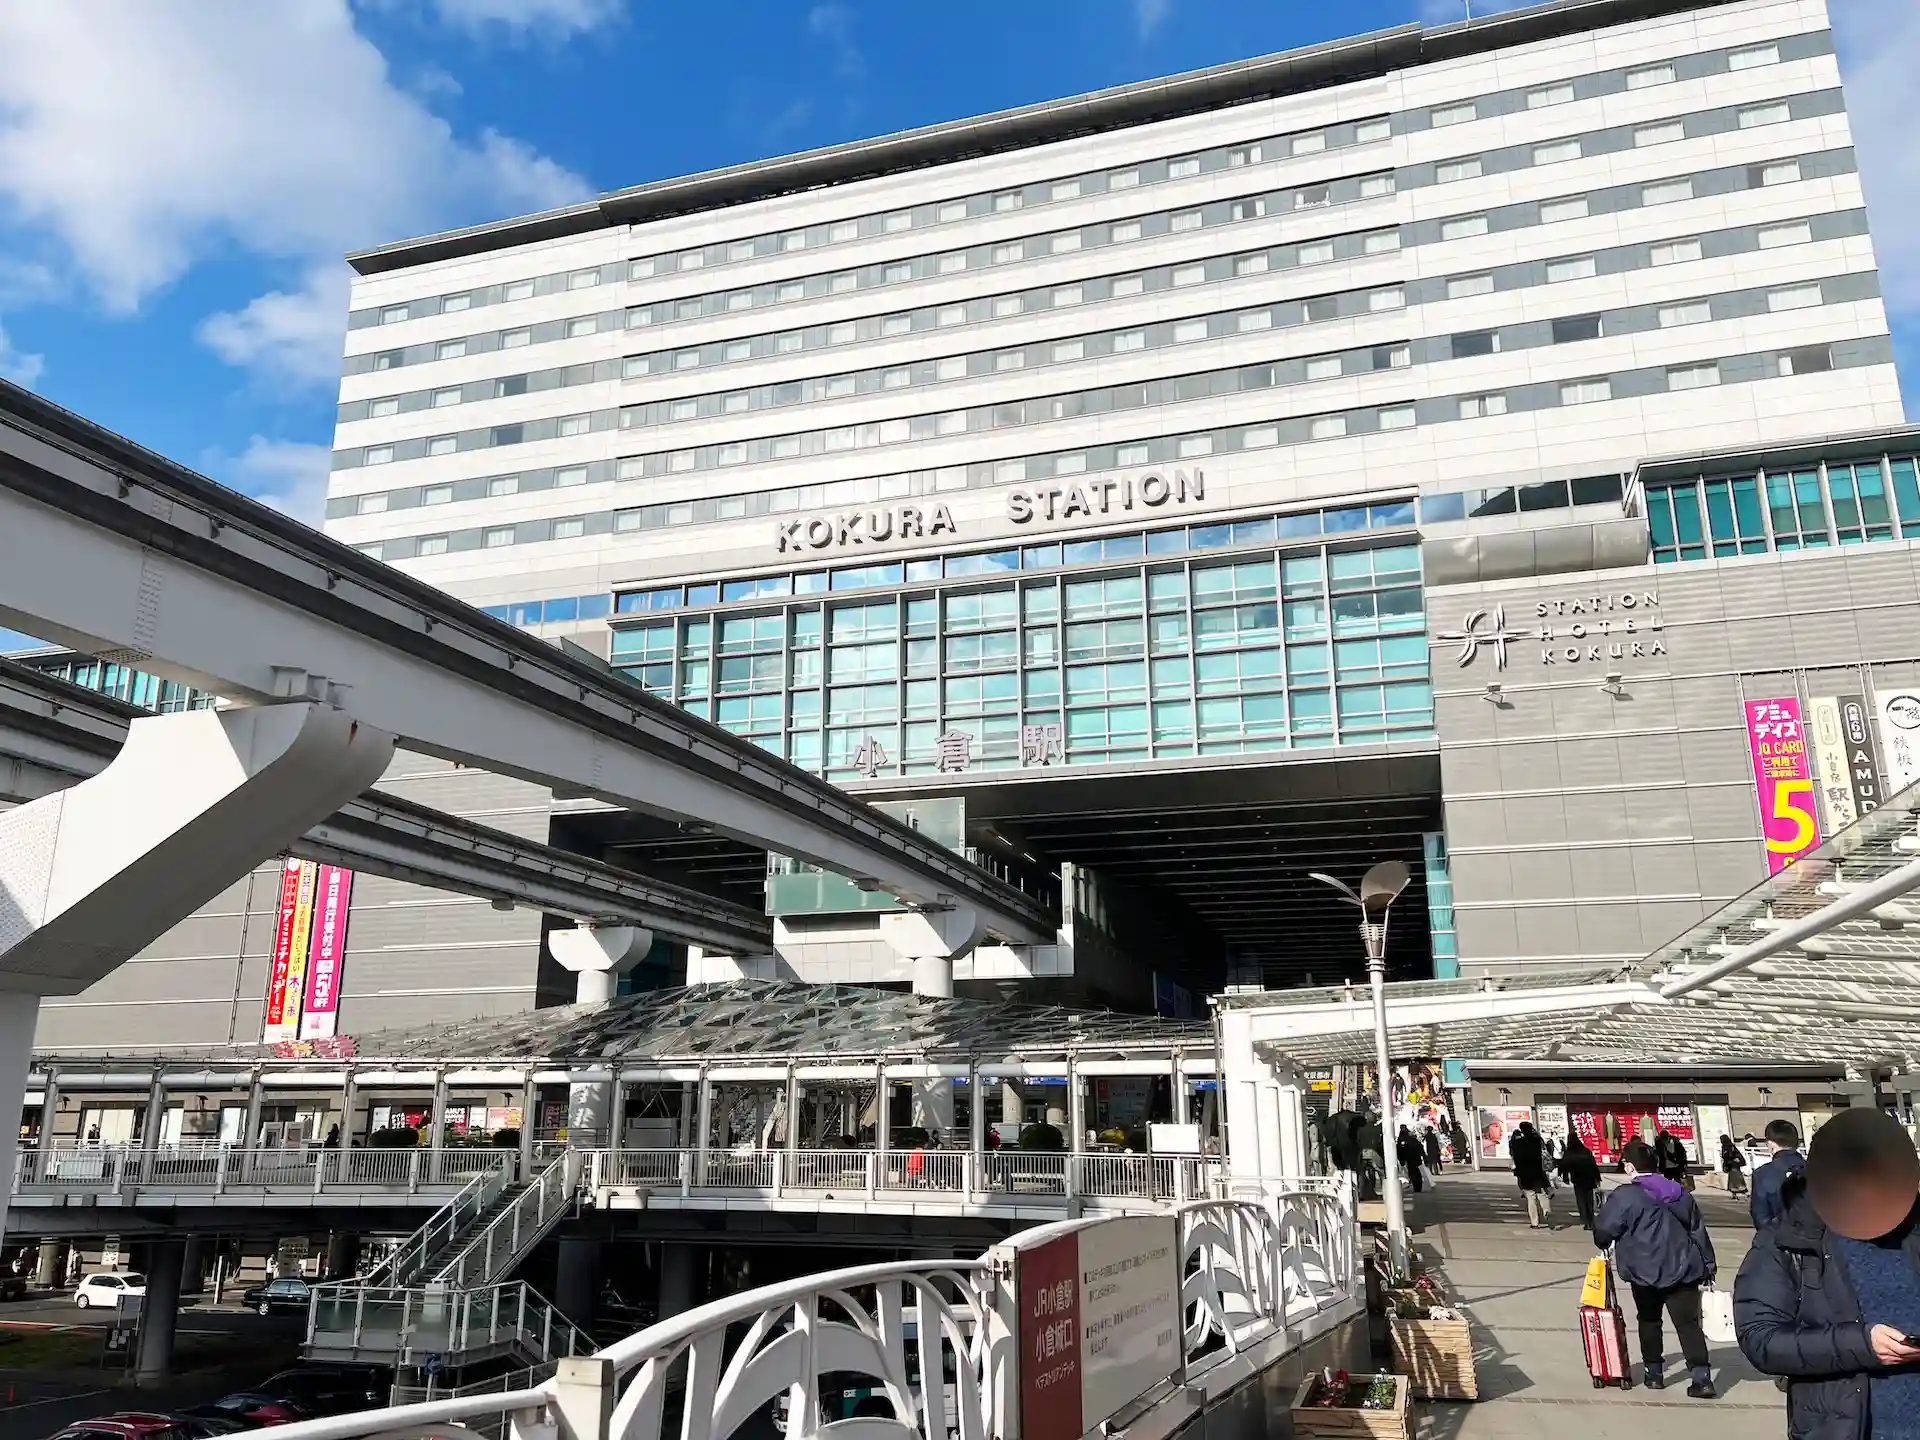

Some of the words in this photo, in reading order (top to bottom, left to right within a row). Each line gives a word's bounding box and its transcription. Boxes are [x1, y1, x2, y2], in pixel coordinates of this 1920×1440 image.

[775, 502, 957, 552] KOKURA
[1006, 466, 1206, 525] STATION
[1536, 591, 1660, 617] STATION
[1540, 615, 1663, 641] HOTEL
[1541, 640, 1667, 665] KOKURA
[1754, 703, 1792, 721] アミュ
[854, 723, 1064, 777] 小倉駅
[1774, 739, 1804, 755] CARD
[1657, 1106, 1690, 1115] AMU'S
[1034, 1280, 1073, 1318] JR小倉駅
[1036, 1318, 1073, 1362] 小倉城口
